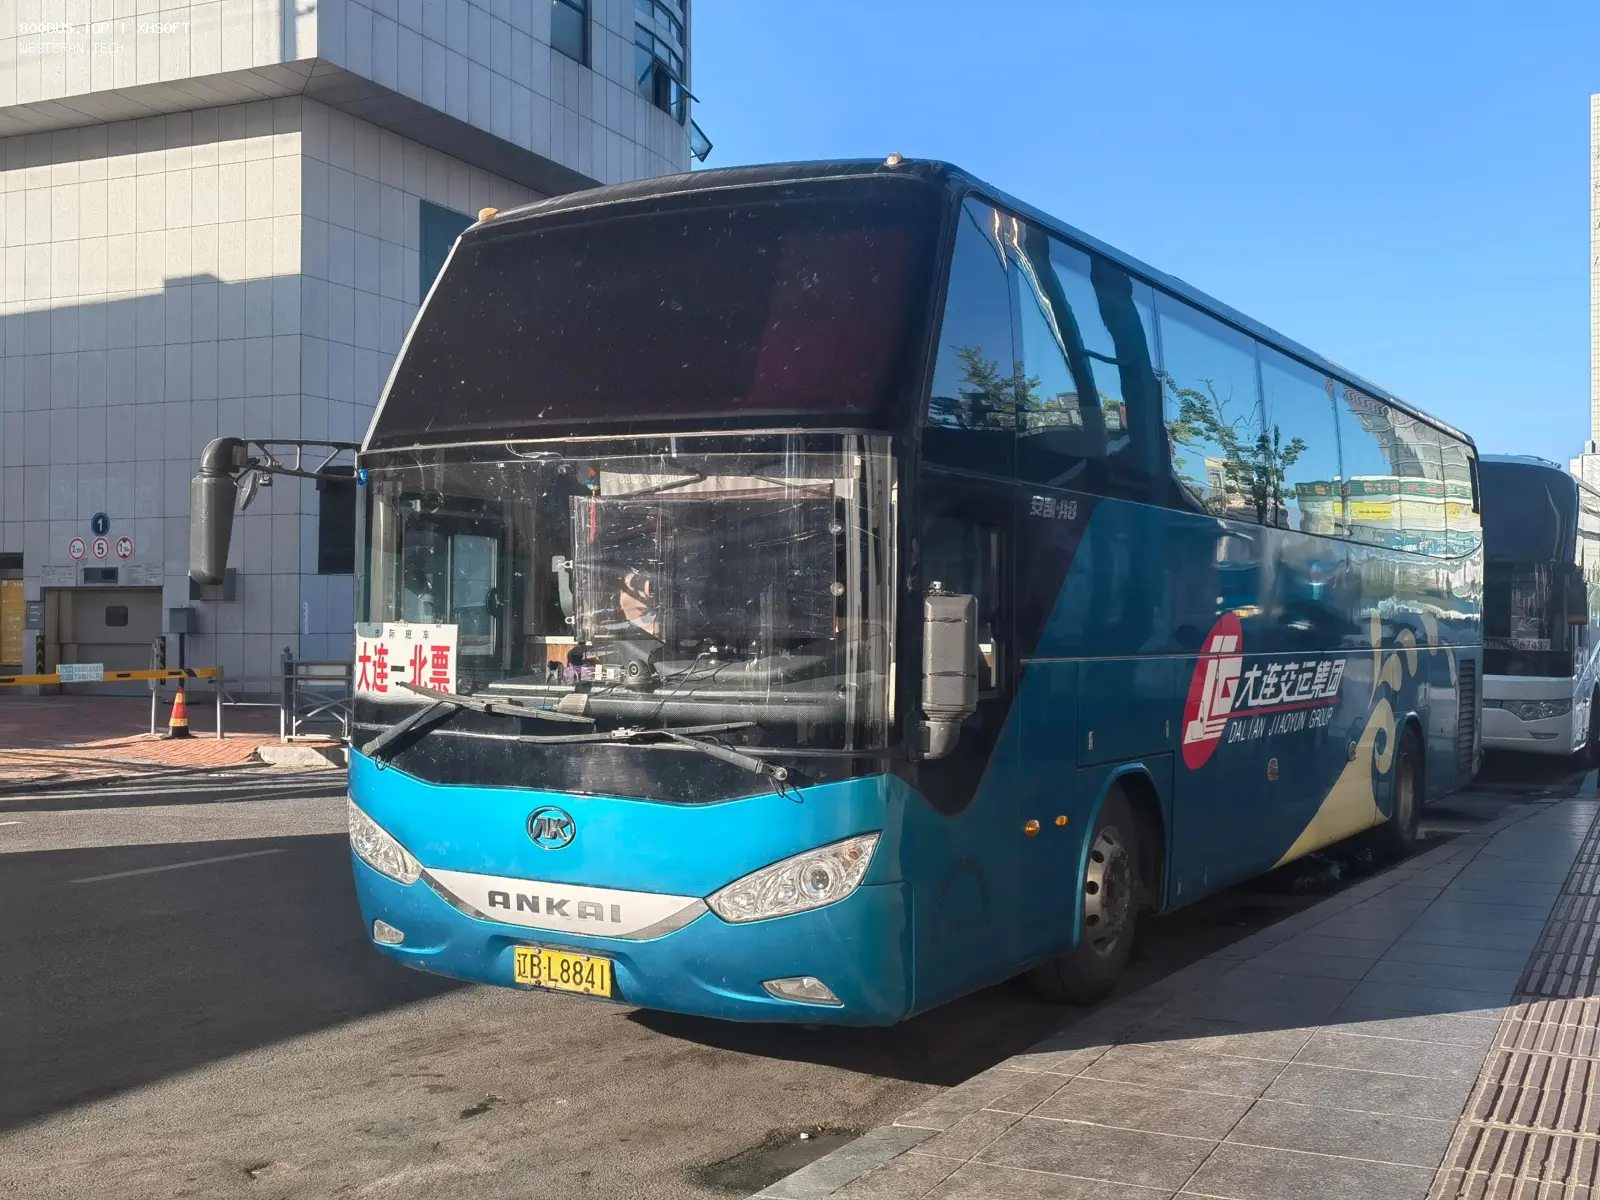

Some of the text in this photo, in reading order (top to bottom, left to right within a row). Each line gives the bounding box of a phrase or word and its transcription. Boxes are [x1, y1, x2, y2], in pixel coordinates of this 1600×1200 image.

[97, 518, 103, 531] 1
[97, 543, 105, 555] 5
[1234, 659, 1347, 708] 大连交运集团
[1228, 706, 1334, 744] DALIAN JIAOYUN GROUP
[487, 890, 621, 923] ANKAI
